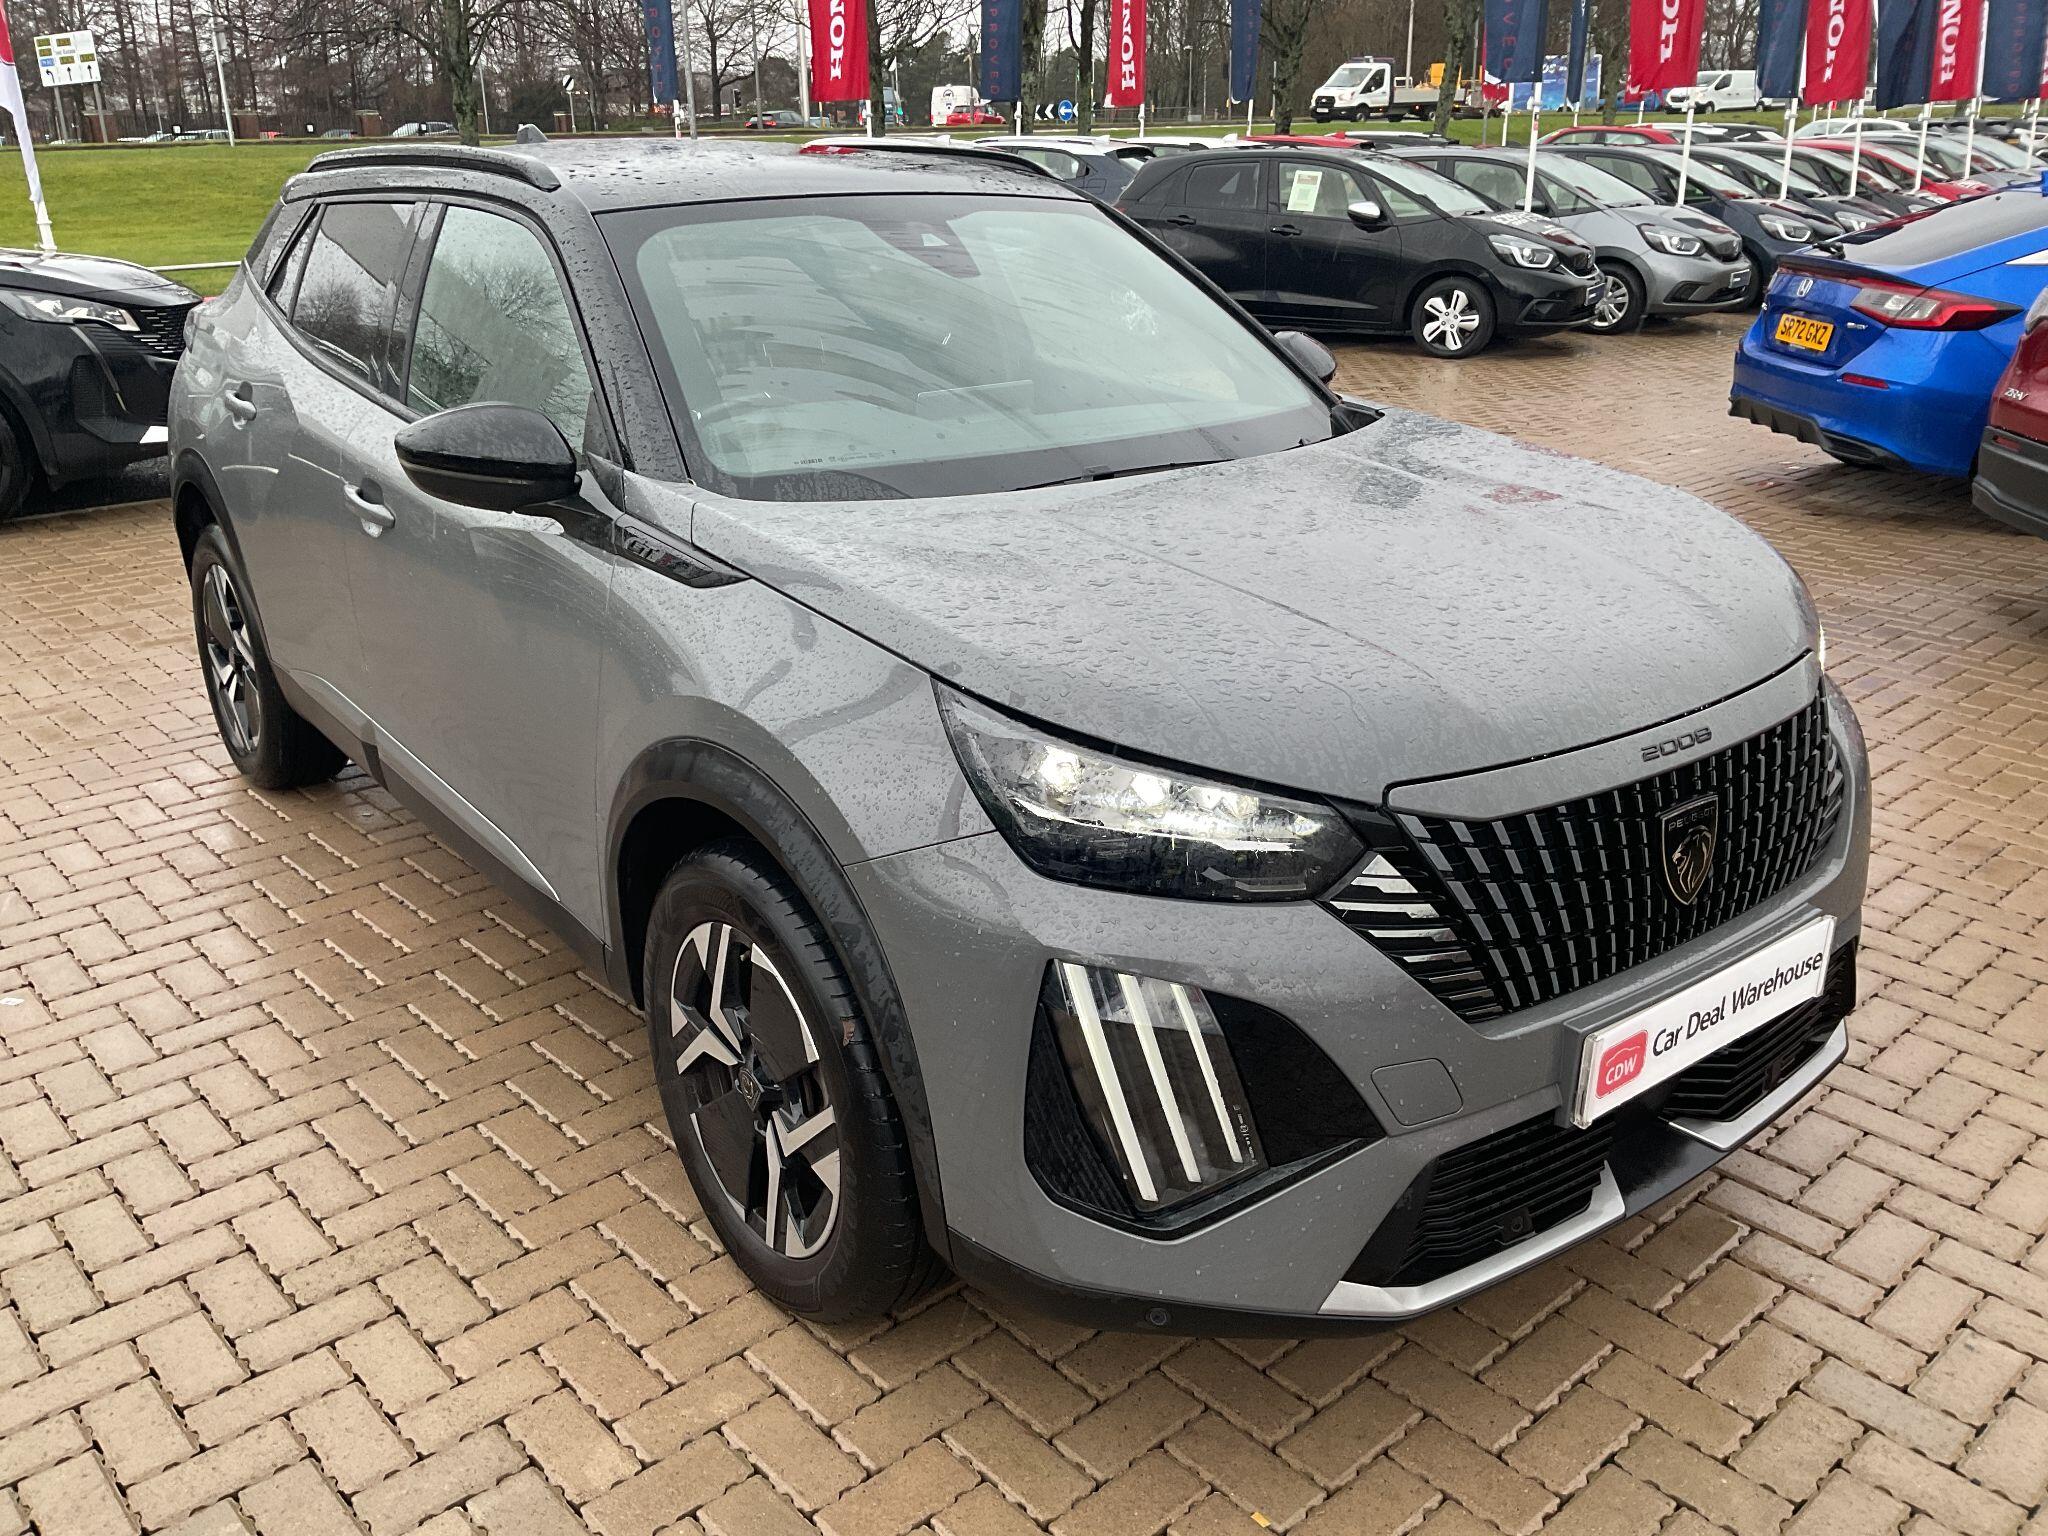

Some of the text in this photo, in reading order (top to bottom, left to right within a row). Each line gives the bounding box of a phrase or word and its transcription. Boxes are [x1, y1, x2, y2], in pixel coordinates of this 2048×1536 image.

[989, 0, 1000, 95] PROVED
[1780, 317, 1807, 340] SR72
[1805, 323, 1829, 345] GXZ
[1640, 727, 1713, 763] 2008
[1652, 951, 1824, 1057] Car Deal Warehouse
[1605, 1057, 1638, 1086] CDW
